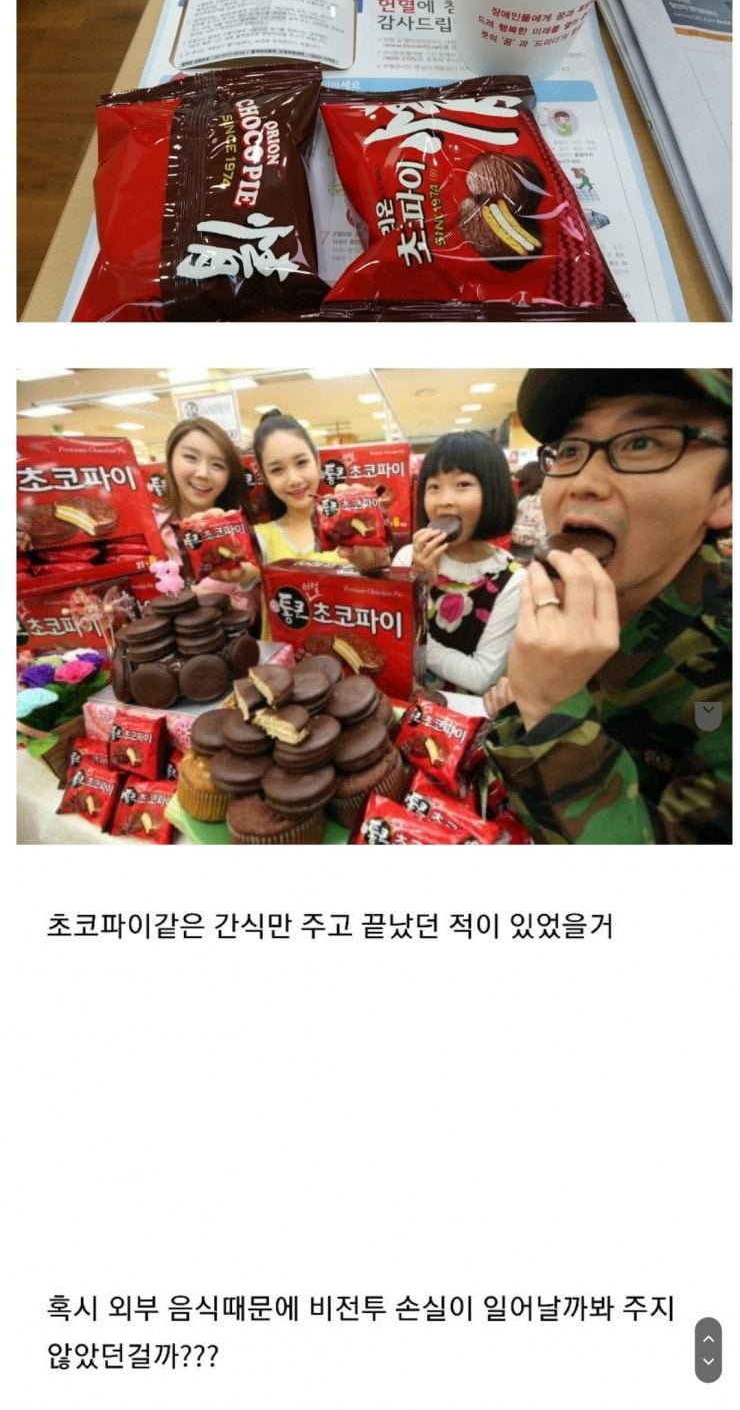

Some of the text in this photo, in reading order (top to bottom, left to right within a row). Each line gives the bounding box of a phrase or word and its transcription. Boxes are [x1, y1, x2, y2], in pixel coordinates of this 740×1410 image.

[221, 114, 237, 188] SINCE 1974
[265, 120, 280, 166] ORION
[17, 466, 137, 491] 초코파이
[349, 462, 405, 479] 초코파이
[27, 617, 103, 638] 초코파이
[312, 602, 403, 639] 초코파이
